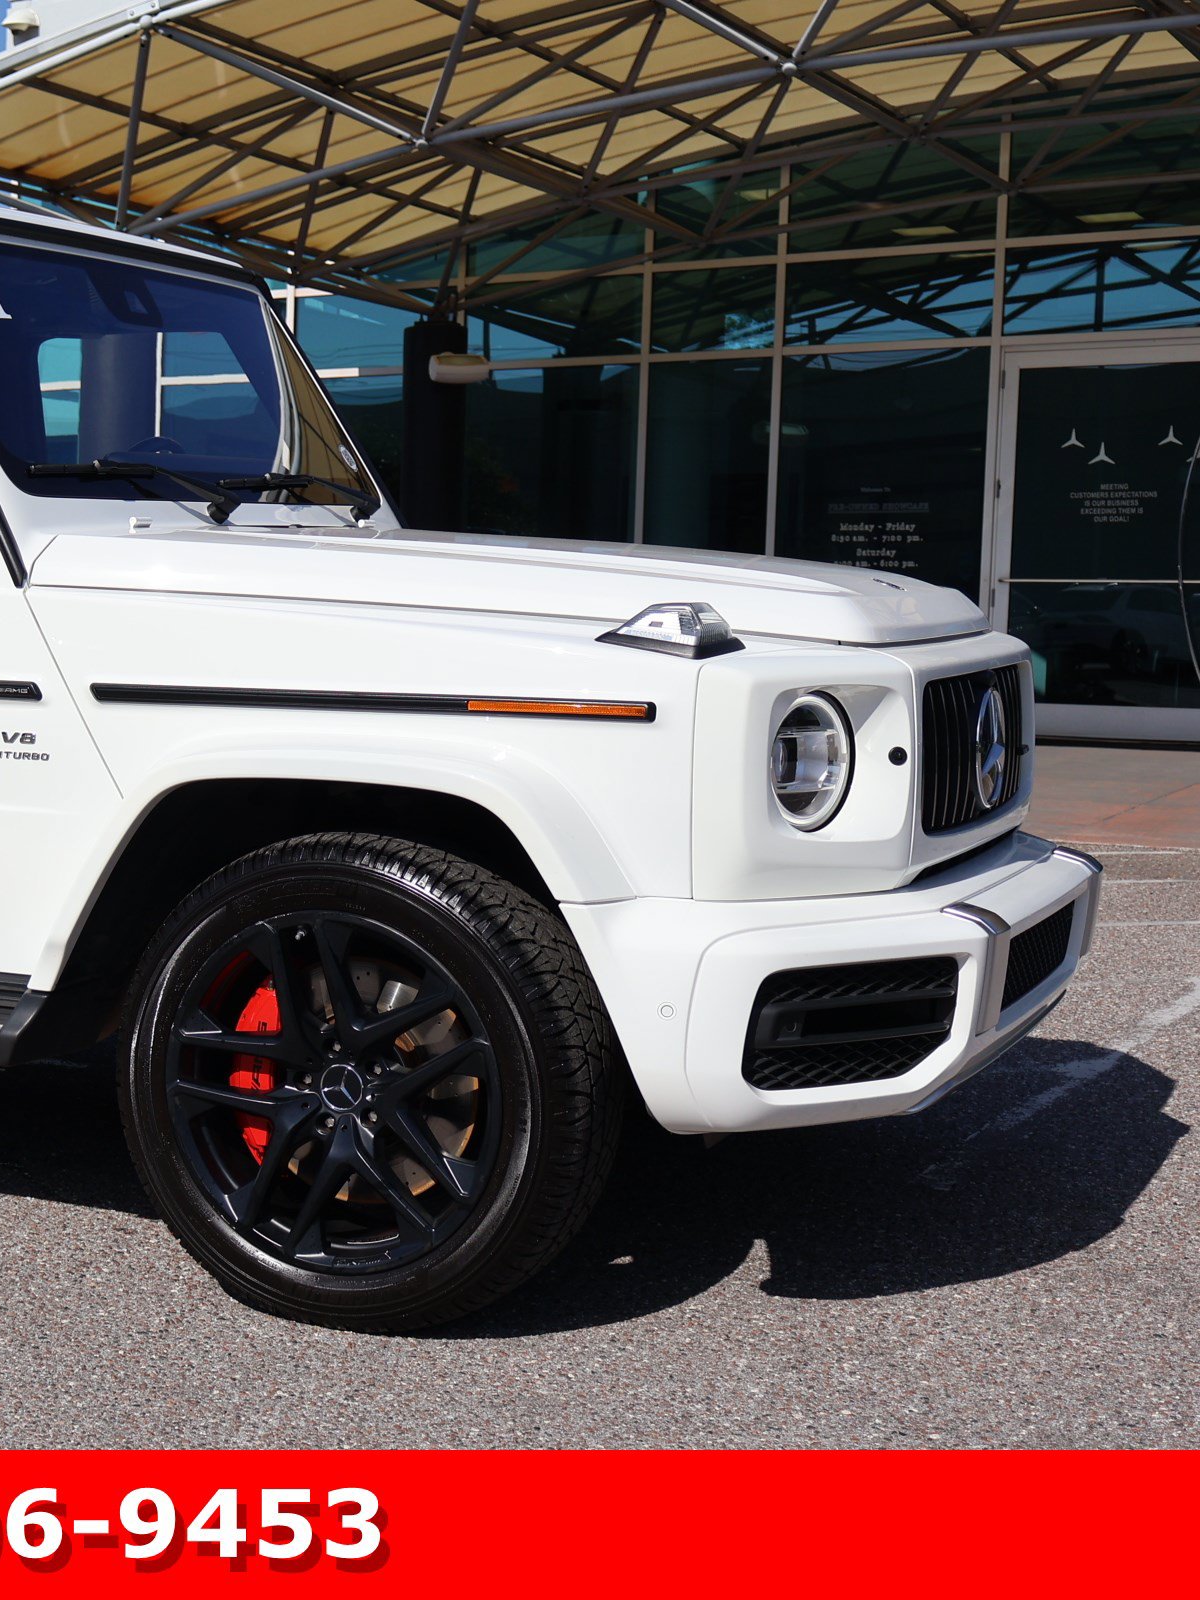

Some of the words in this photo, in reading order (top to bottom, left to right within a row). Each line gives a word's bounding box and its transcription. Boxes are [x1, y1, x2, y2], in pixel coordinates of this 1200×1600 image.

[840, 522, 875, 532] Monday
[885, 522, 916, 532] Friday
[856, 548, 896, 558] Saturday
[880, 559, 899, 567] 6:00
[1, 731, 36, 745] V8
